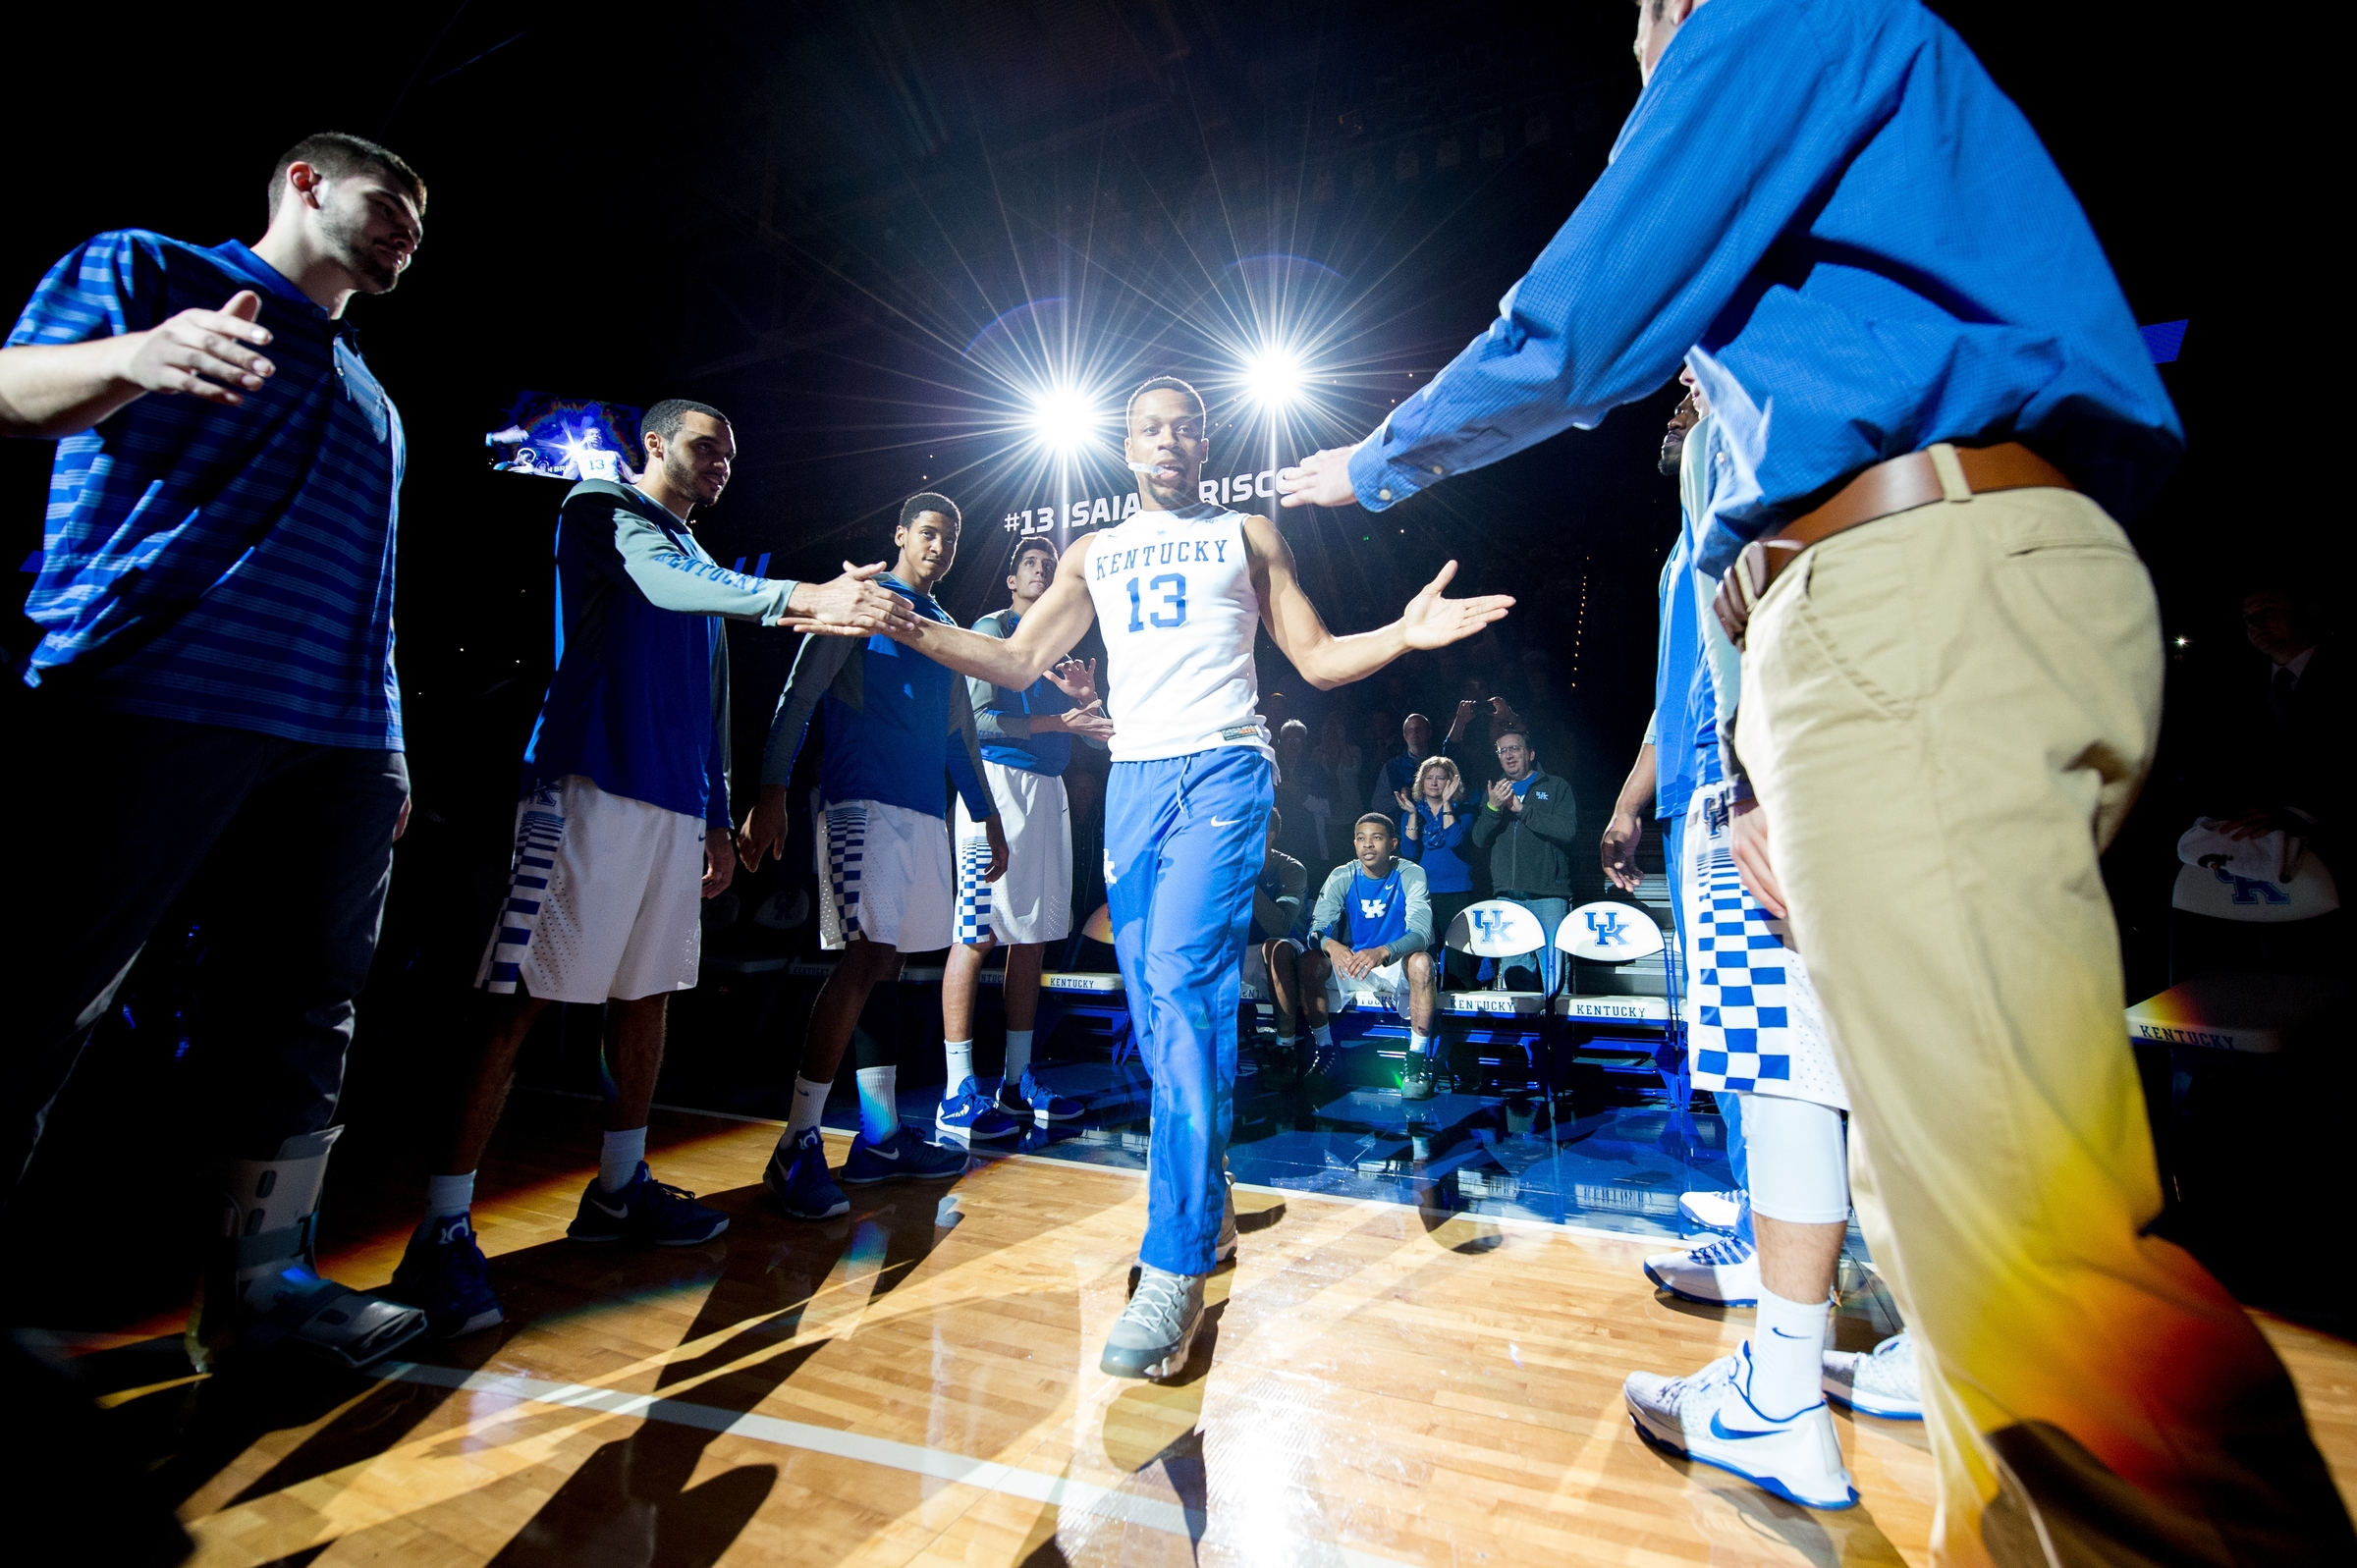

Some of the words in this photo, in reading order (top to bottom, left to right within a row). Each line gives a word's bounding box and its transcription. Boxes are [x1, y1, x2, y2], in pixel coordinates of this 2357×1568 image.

[589, 459, 605, 470] 13
[1004, 507, 1055, 536] #13
[1062, 492, 1141, 529] ISAIA
[654, 552, 769, 595] KENTUCKY
[1096, 539, 1228, 581] KENTUCKY
[1125, 572, 1187, 633] 13
[1360, 898, 1387, 919] UK
[1469, 908, 1516, 946] UK
[1581, 909, 1632, 947] UK
[1050, 977, 1095, 989] KENTUCKY
[1450, 999, 1514, 1011] KENTUCKY
[1576, 1004, 1645, 1017] KENTUCKY
[2139, 1024, 2236, 1051] KENTUCKY
